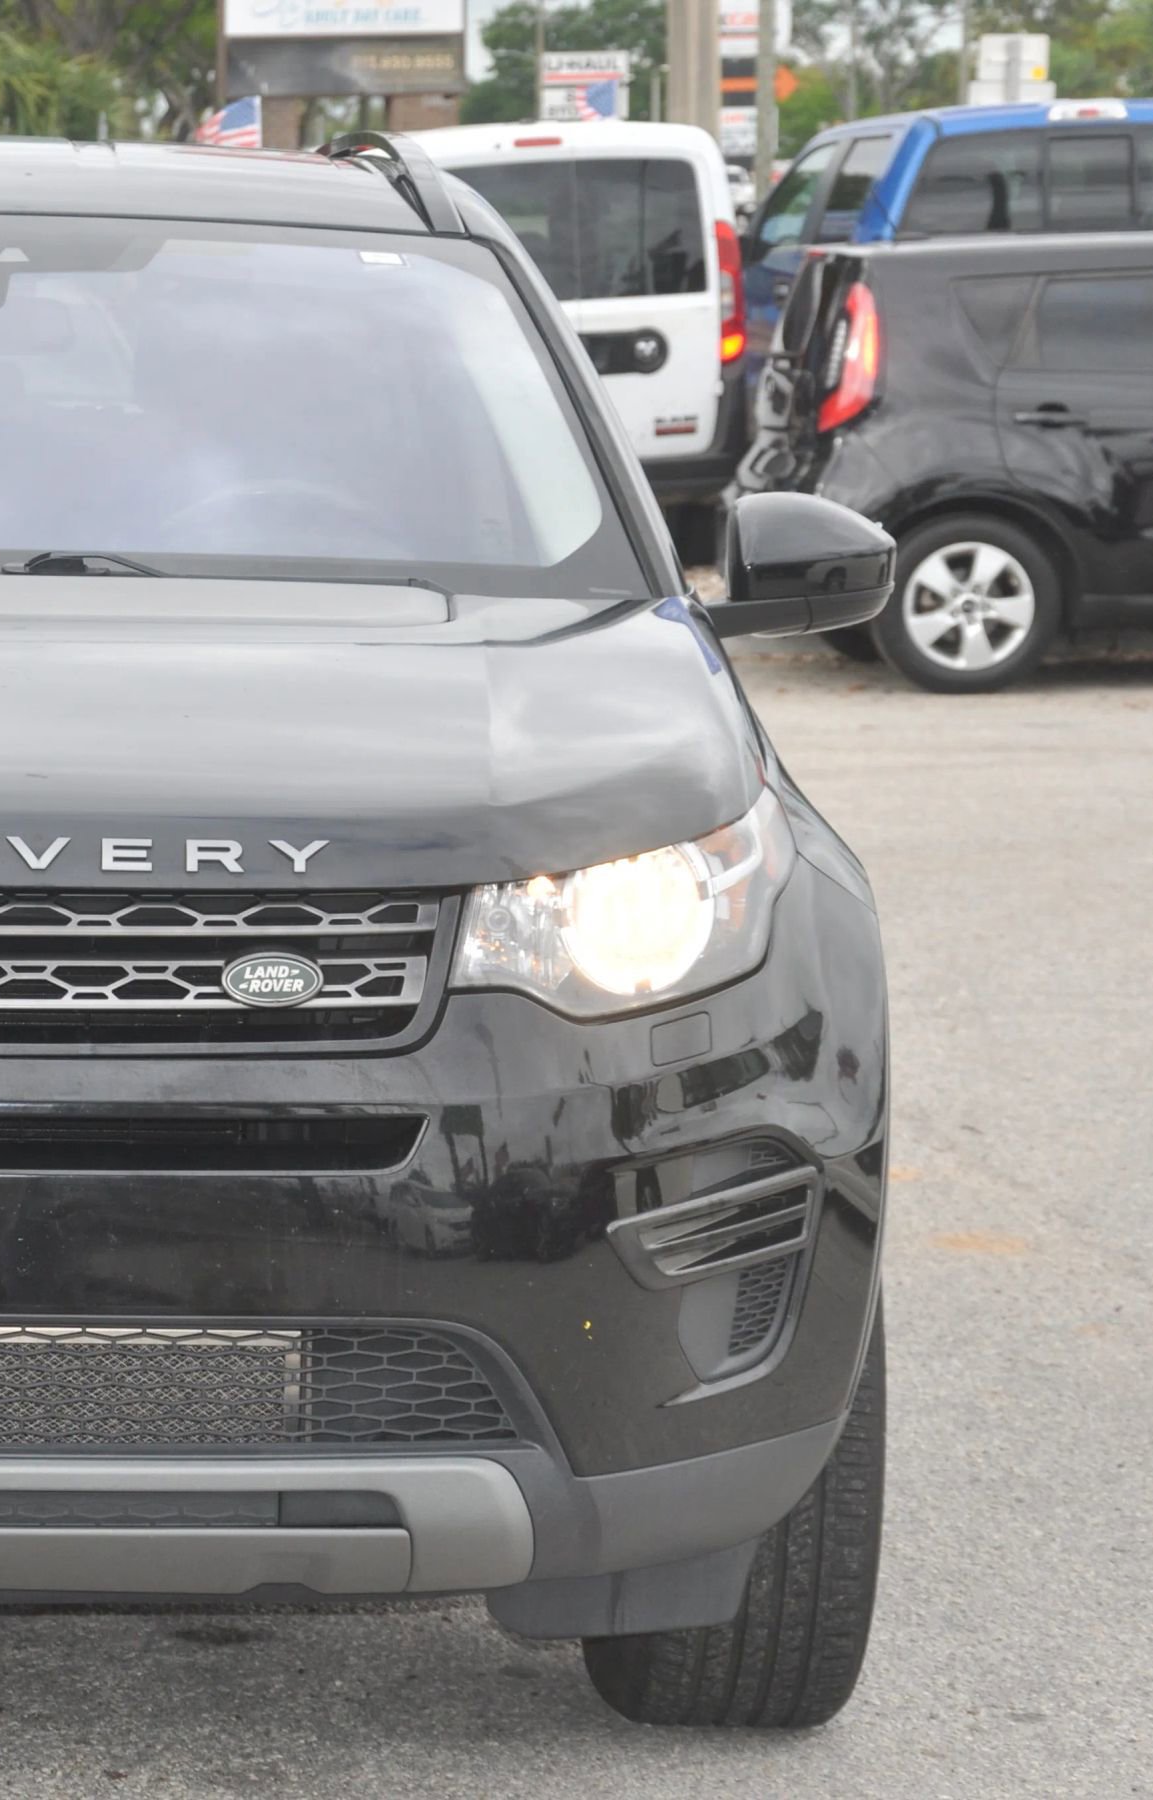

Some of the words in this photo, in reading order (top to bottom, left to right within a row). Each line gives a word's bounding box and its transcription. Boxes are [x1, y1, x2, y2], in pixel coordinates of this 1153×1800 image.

[353, 8, 379, 22] DAY
[385, 7, 421, 22] CARE
[544, 56, 617, 71] U-HAUL
[244, 965, 290, 979] LAND
[248, 979, 304, 993] ROVER
